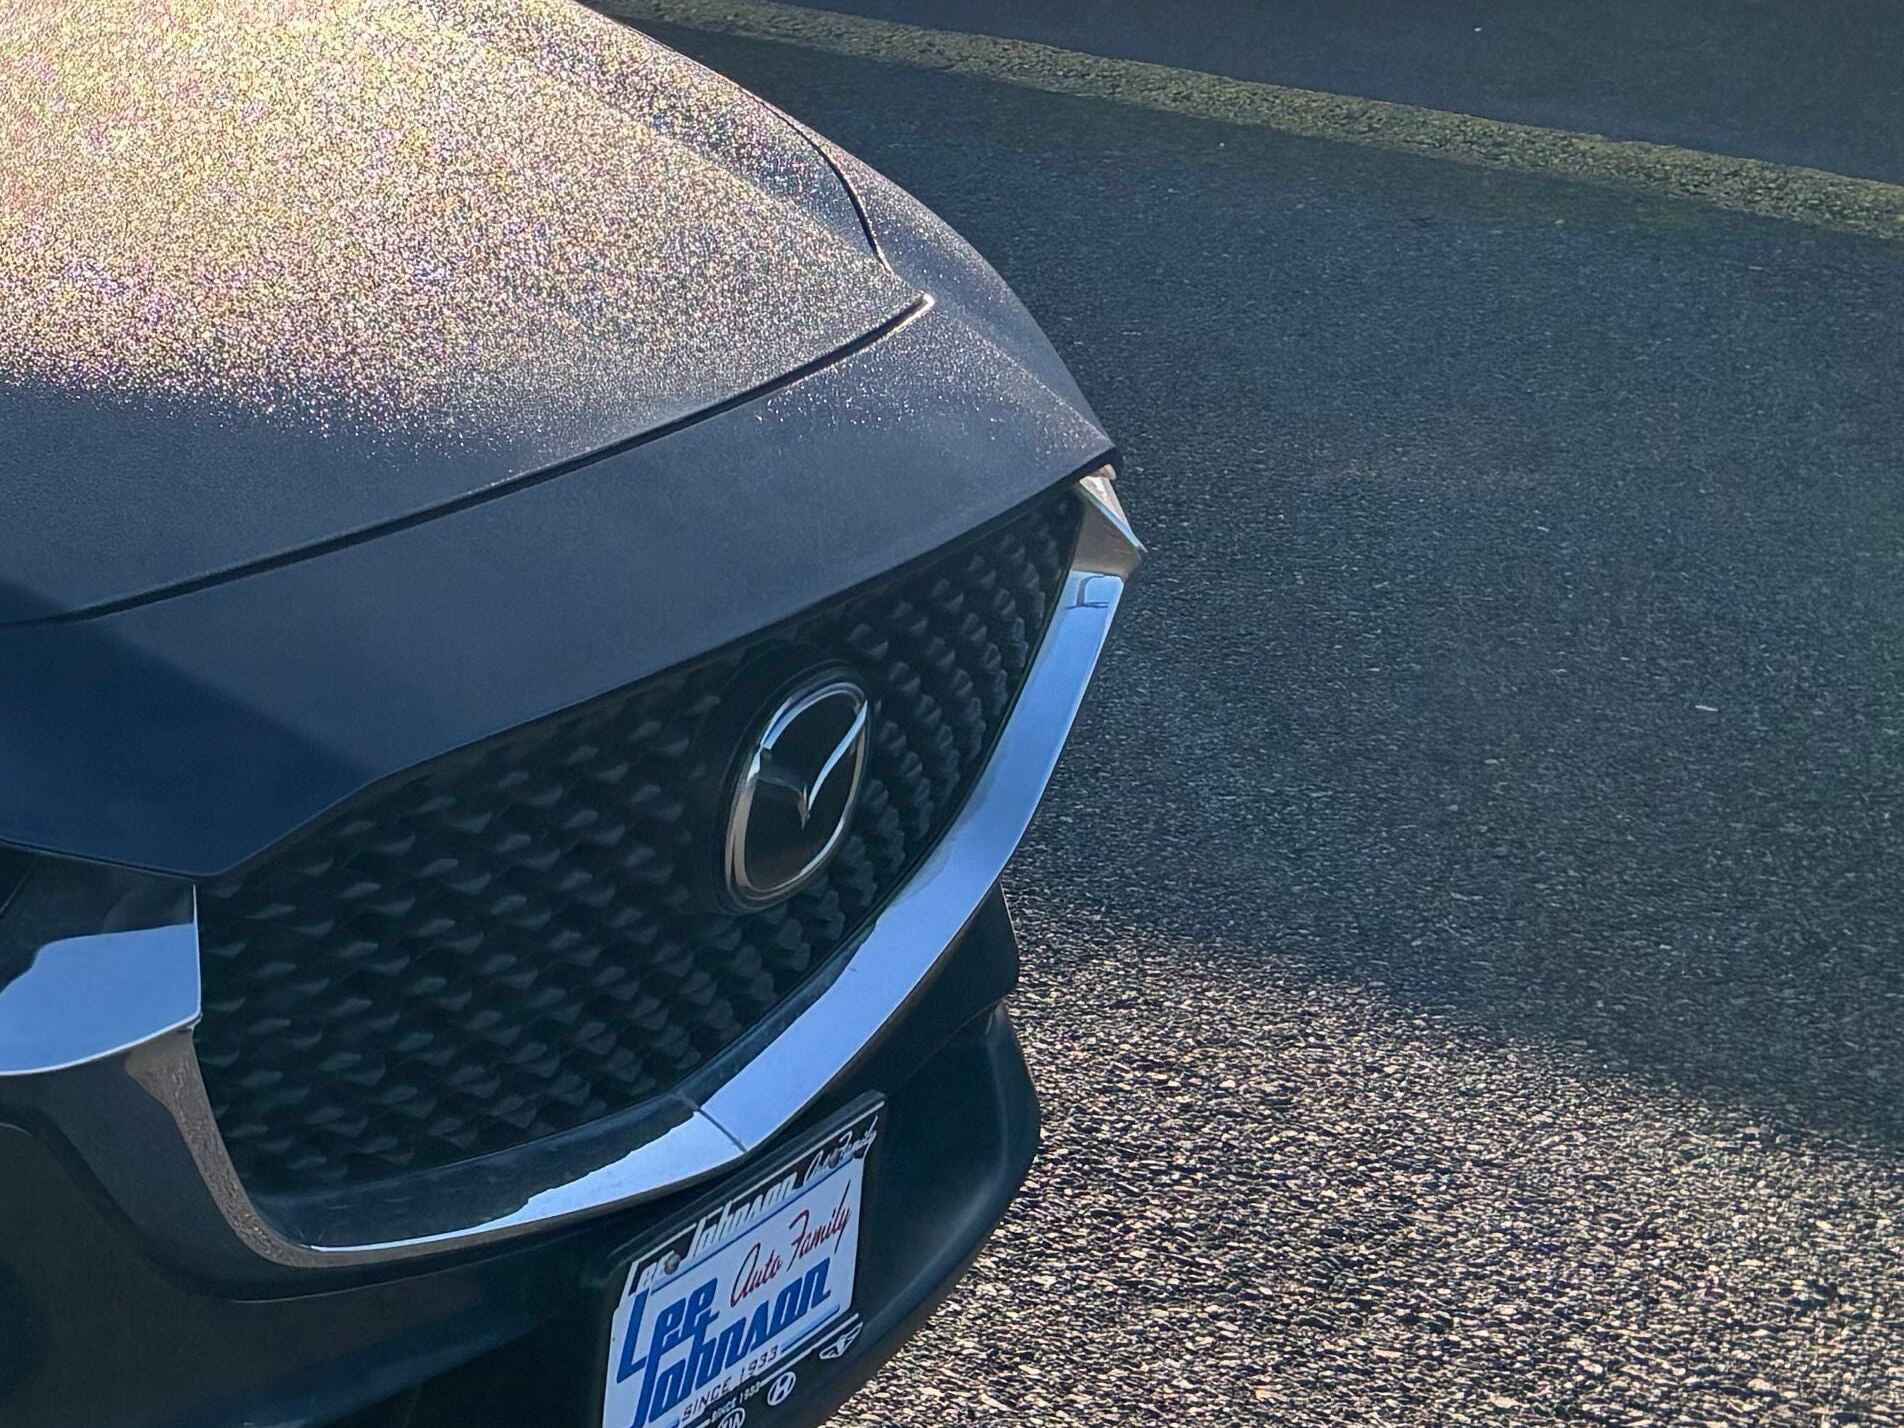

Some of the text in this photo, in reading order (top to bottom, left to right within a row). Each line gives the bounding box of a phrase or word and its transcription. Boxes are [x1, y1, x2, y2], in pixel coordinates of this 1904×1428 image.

[730, 1179, 852, 1309] Auto Family
[616, 1277, 720, 1383] Lee
[681, 1345, 779, 1422] SINCE 1933
